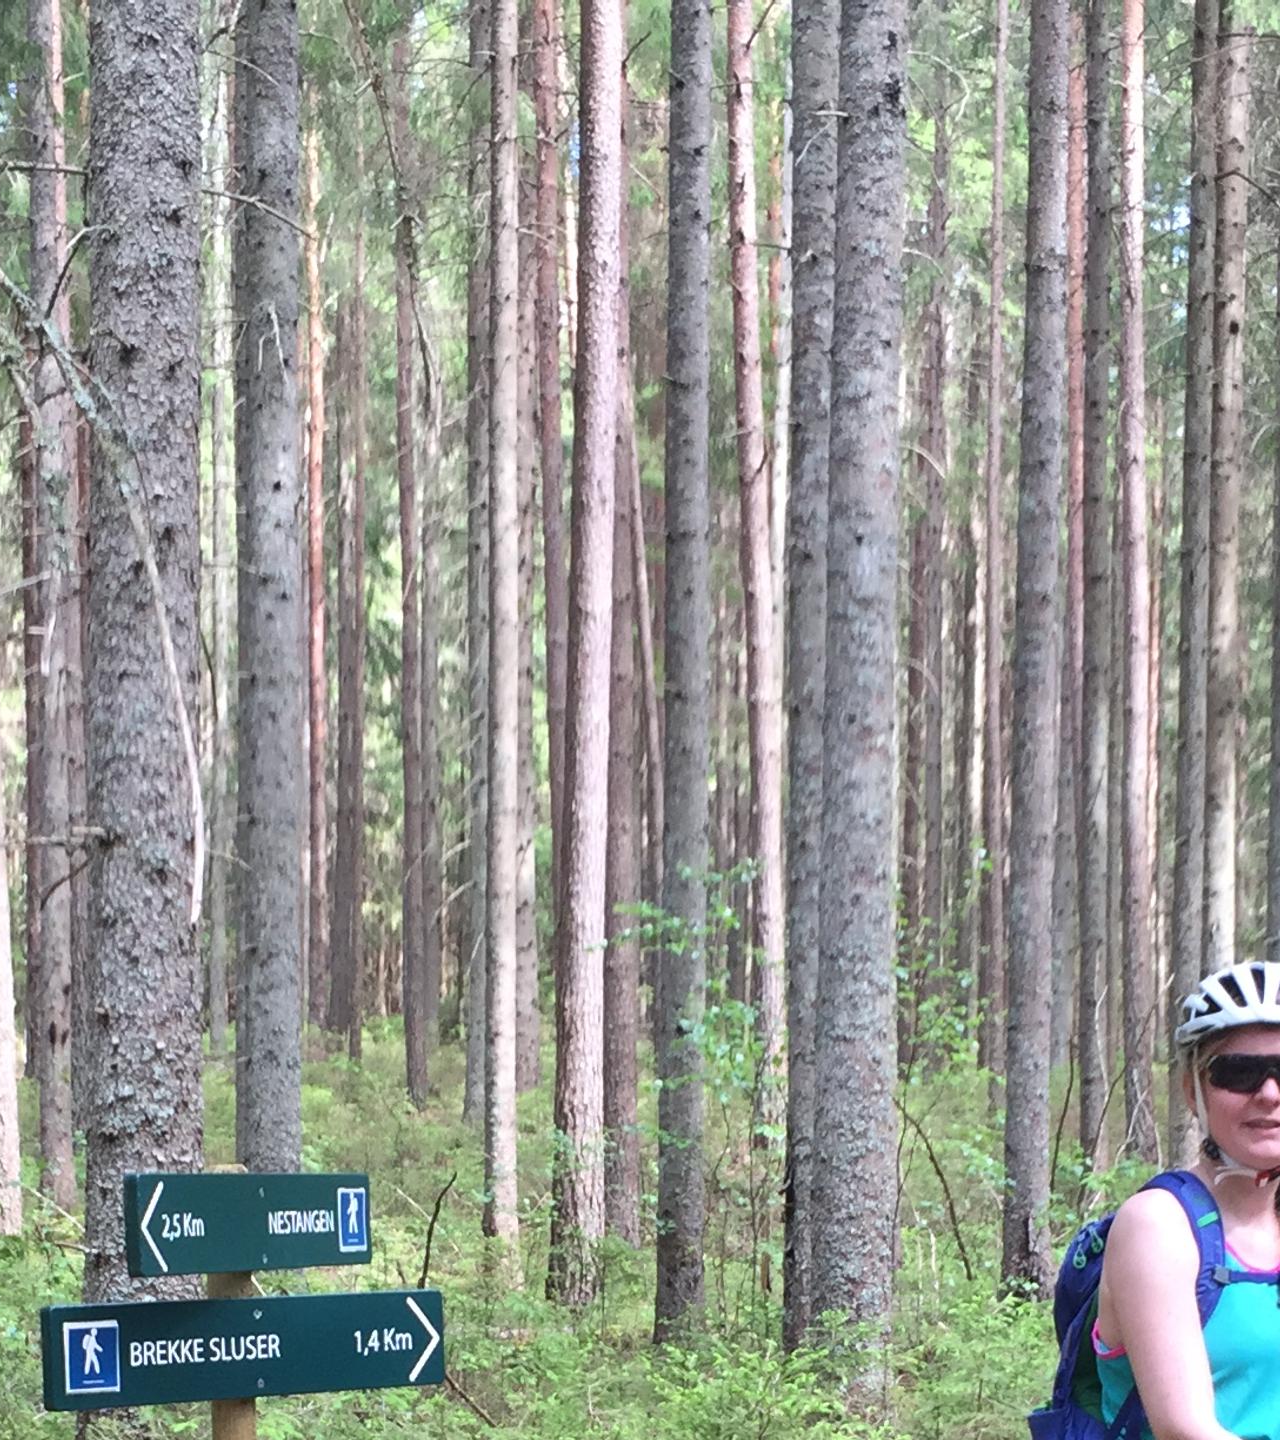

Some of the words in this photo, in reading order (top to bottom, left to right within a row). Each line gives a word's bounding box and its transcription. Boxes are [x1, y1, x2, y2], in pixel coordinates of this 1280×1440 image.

[161, 1213, 181, 1242] 2,5
[183, 1212, 205, 1237] Km
[267, 1210, 335, 1234] NESTANGEN
[130, 1338, 205, 1367] BREKKE
[209, 1334, 281, 1362] SLUSER
[354, 1328, 380, 1356] 1,4
[383, 1326, 413, 1351] Km
